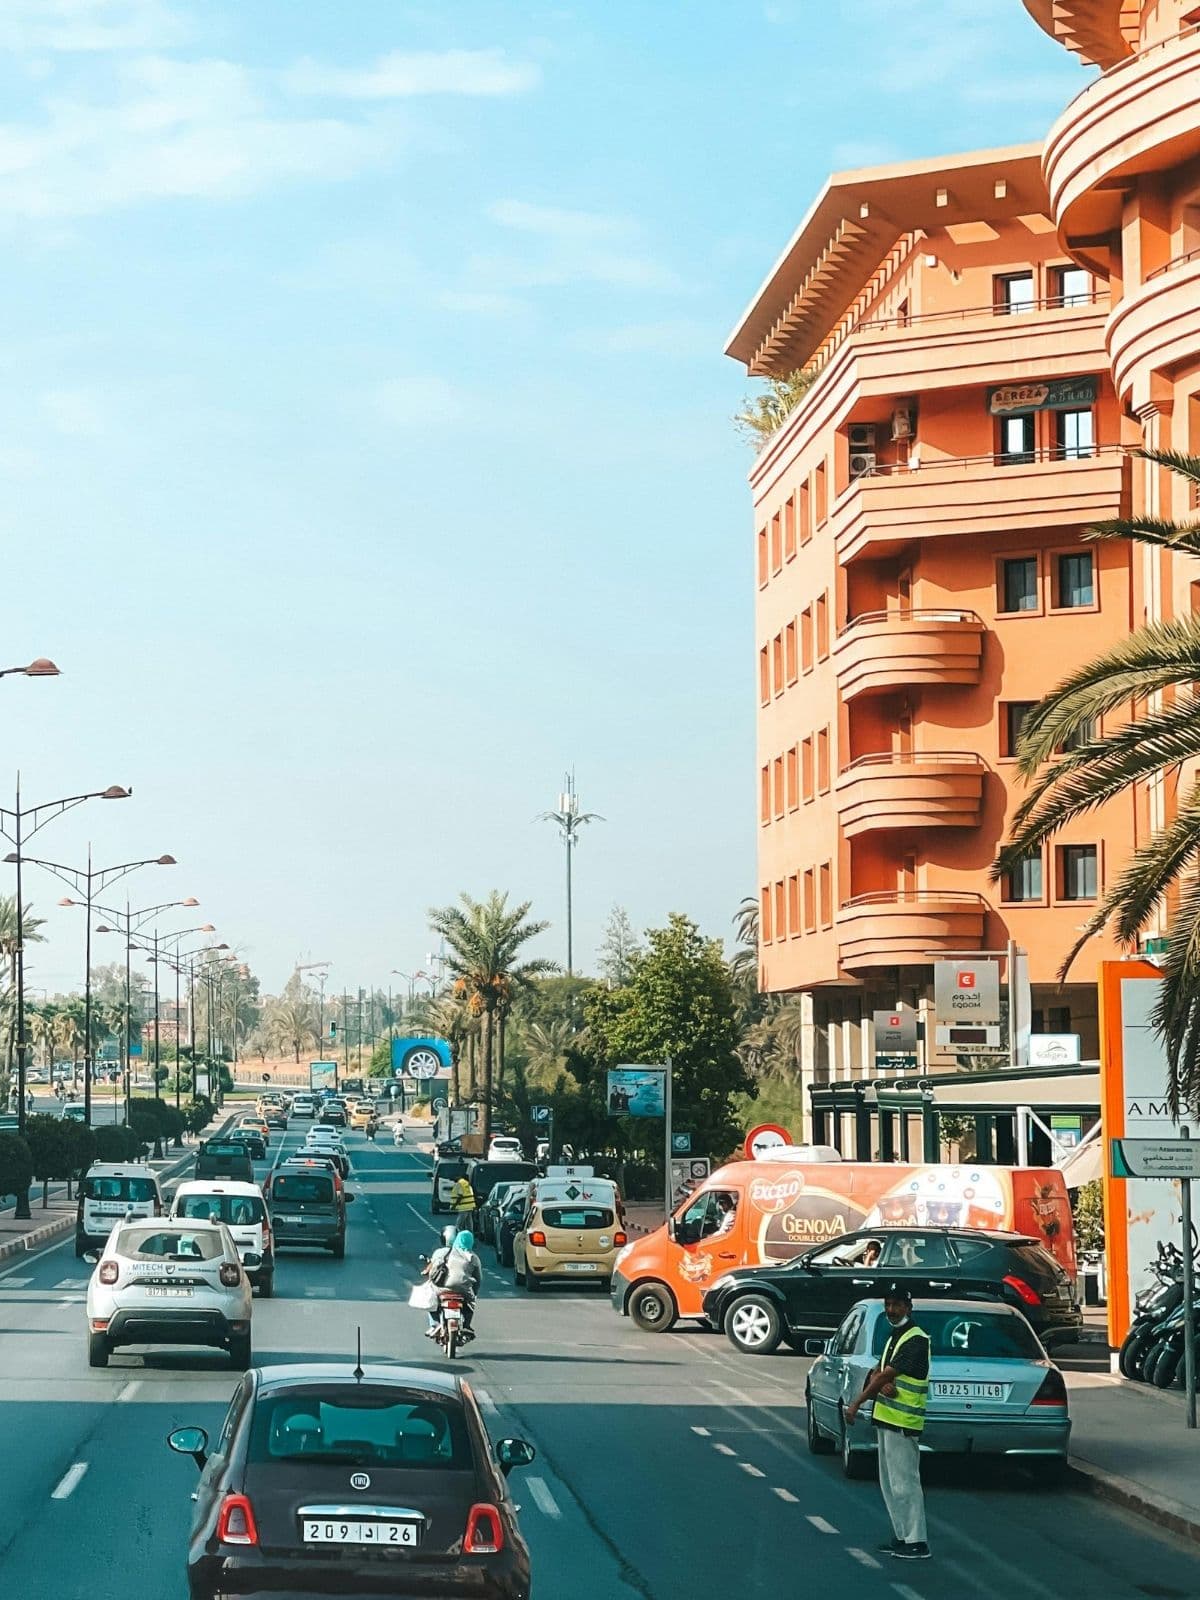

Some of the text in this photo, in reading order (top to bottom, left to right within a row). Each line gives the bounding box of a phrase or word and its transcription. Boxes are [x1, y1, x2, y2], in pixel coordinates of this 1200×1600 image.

[752, 1181, 799, 1200] EXCELO
[938, 1384, 969, 1395] 18225
[310, 1524, 348, 1540] 209
[389, 1526, 411, 1542] 26
